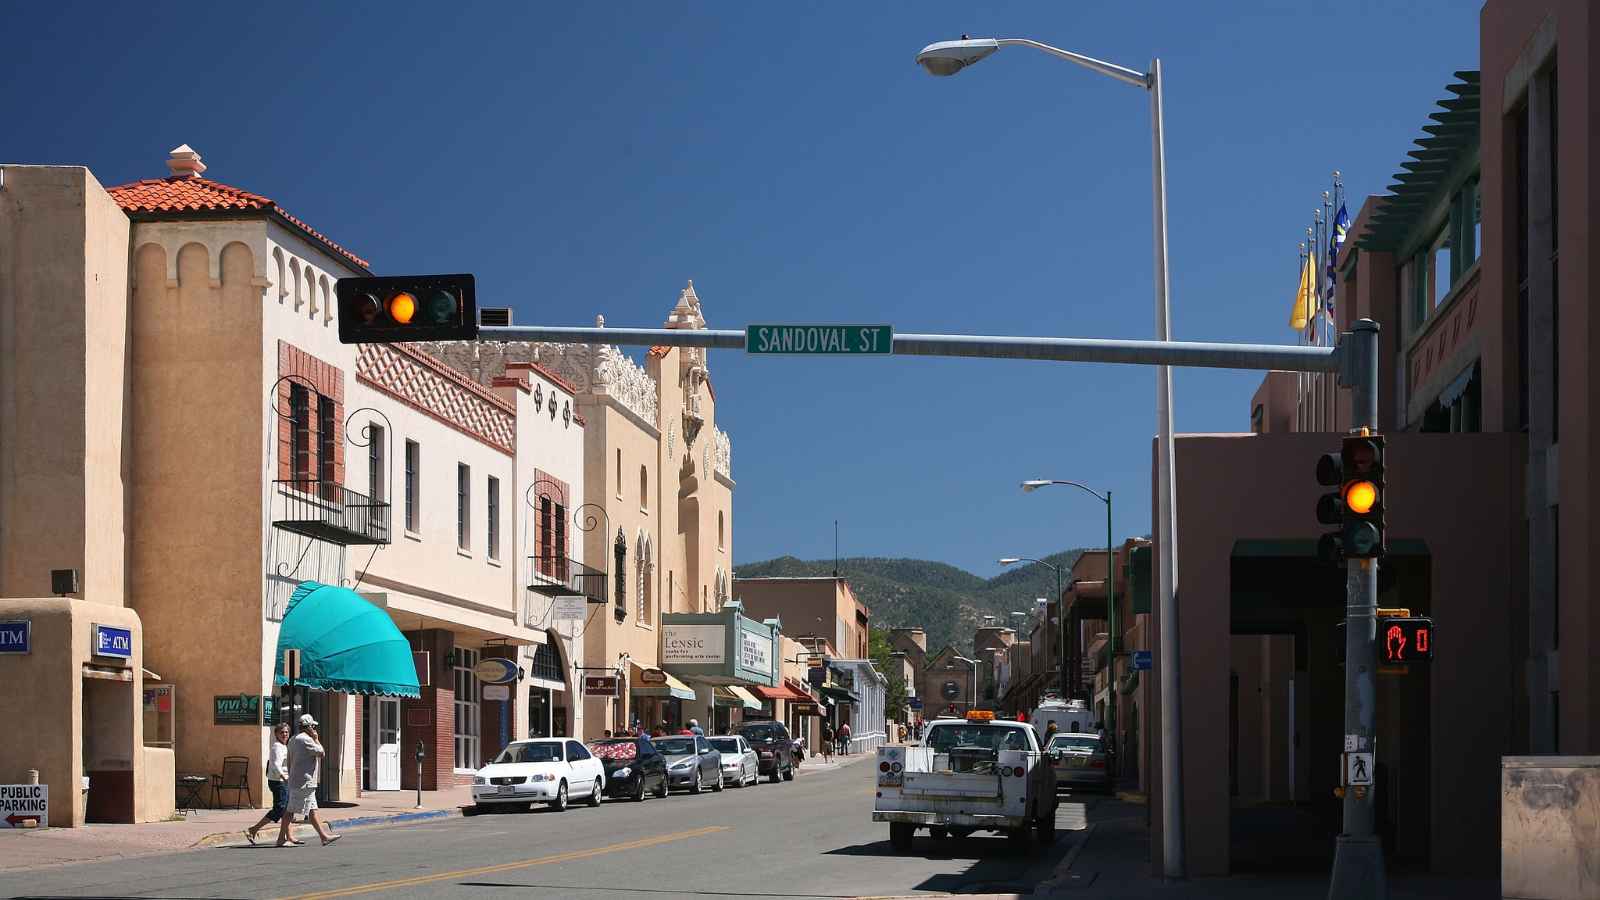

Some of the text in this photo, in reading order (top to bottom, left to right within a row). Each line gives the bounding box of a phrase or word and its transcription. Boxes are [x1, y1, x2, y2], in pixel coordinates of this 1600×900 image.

[758, 327, 880, 352] SANDOVAL ST
[112, 636, 129, 650] ATM
[1416, 629, 1428, 652] 0
[1, 786, 41, 799] PUBLIC
